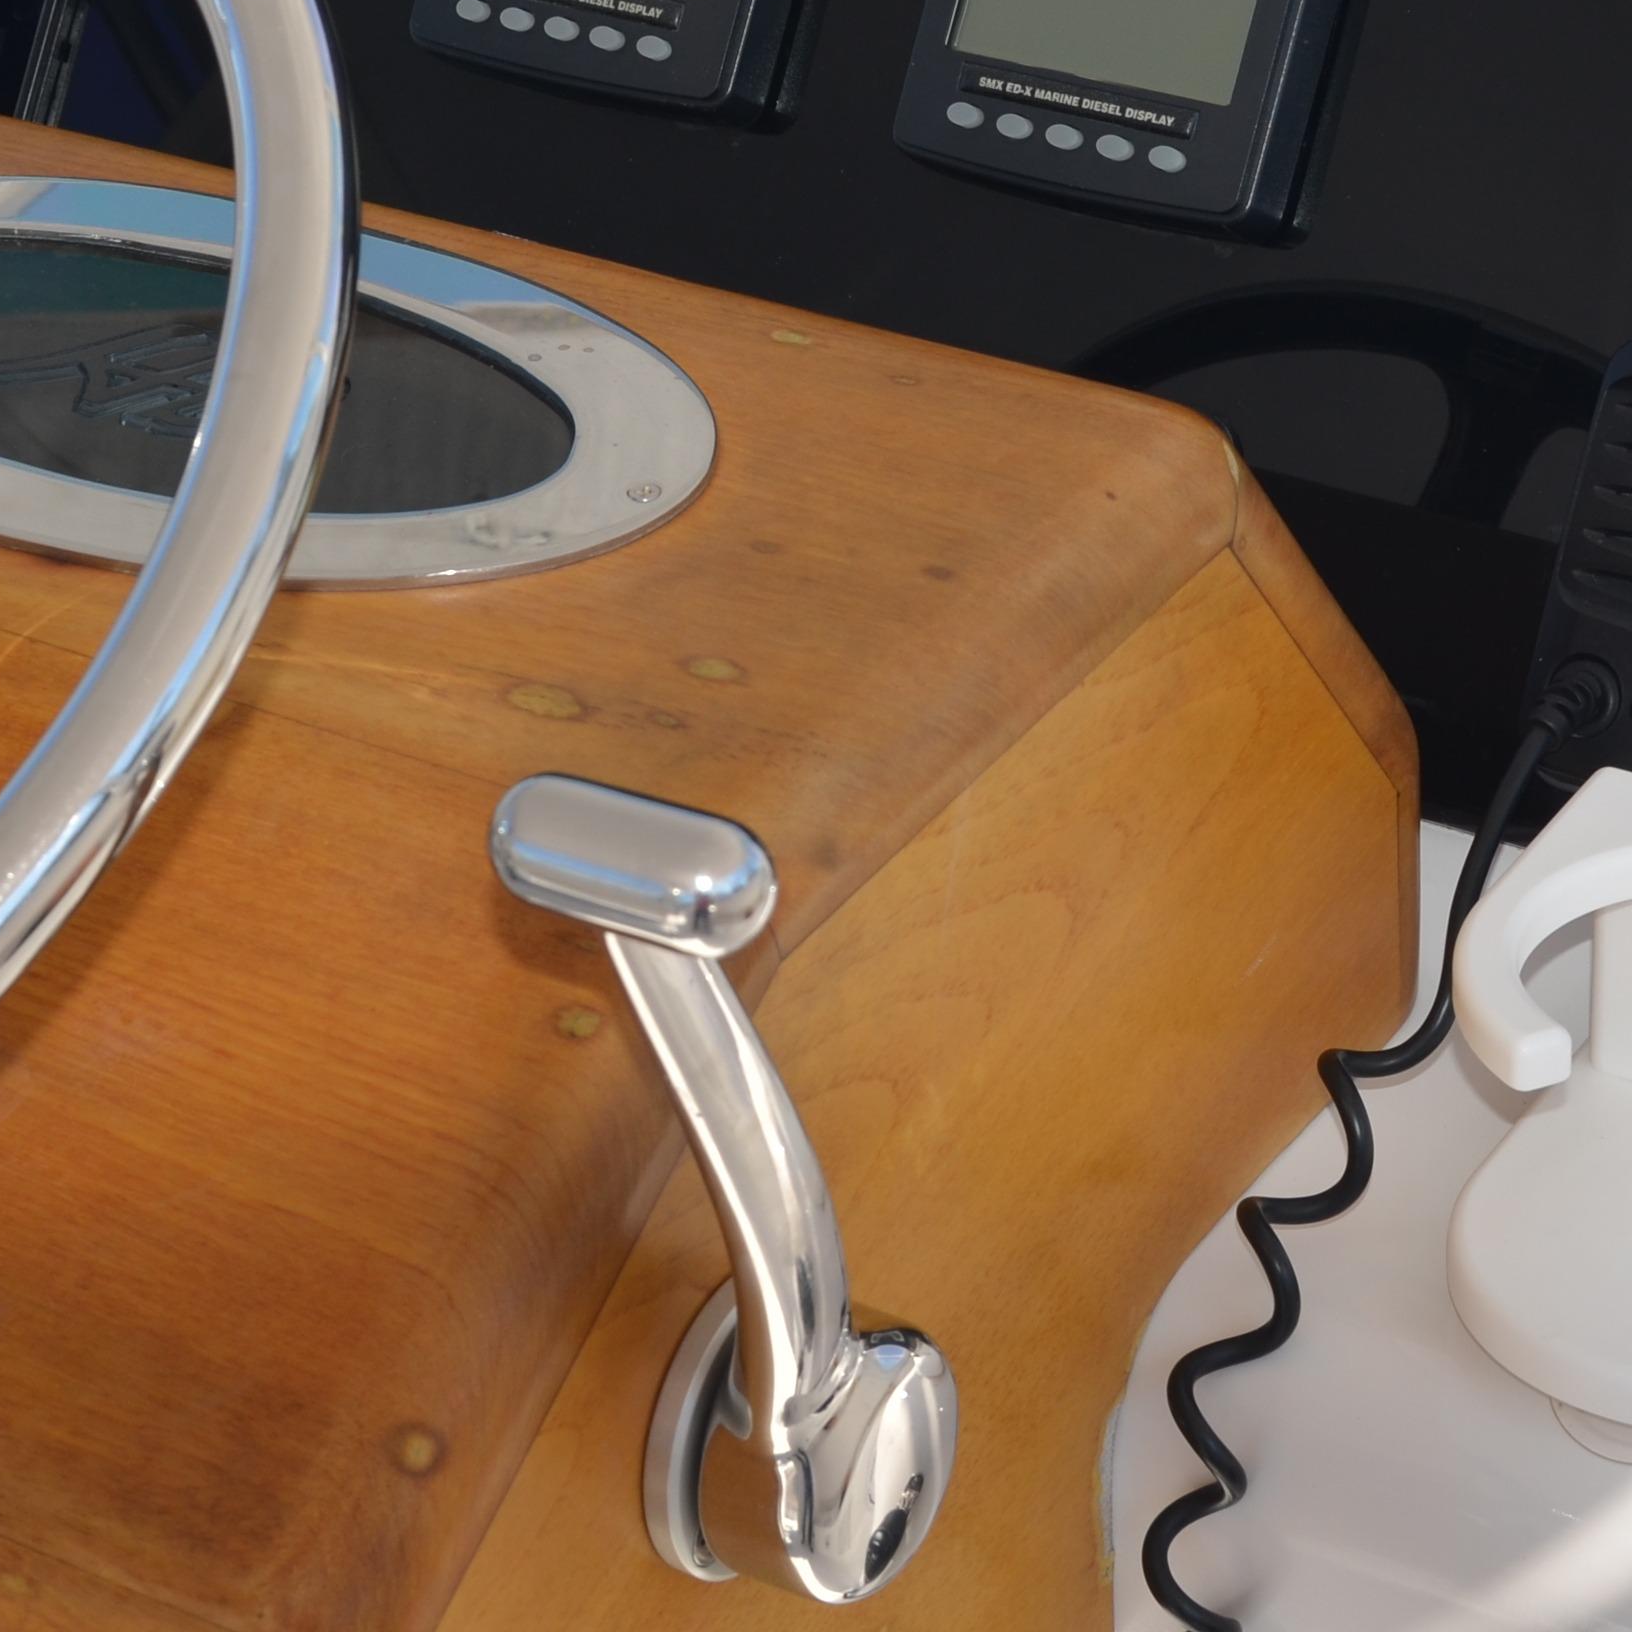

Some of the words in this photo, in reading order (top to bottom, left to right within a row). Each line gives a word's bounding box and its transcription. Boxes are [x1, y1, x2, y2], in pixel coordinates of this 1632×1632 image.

[617, 0, 664, 19] DISPLAY
[978, 76, 1003, 91] SMX
[1034, 88, 1080, 107] MARINE
[1081, 98, 1122, 116] DIESEL
[1125, 107, 1175, 127] DISPLAY
